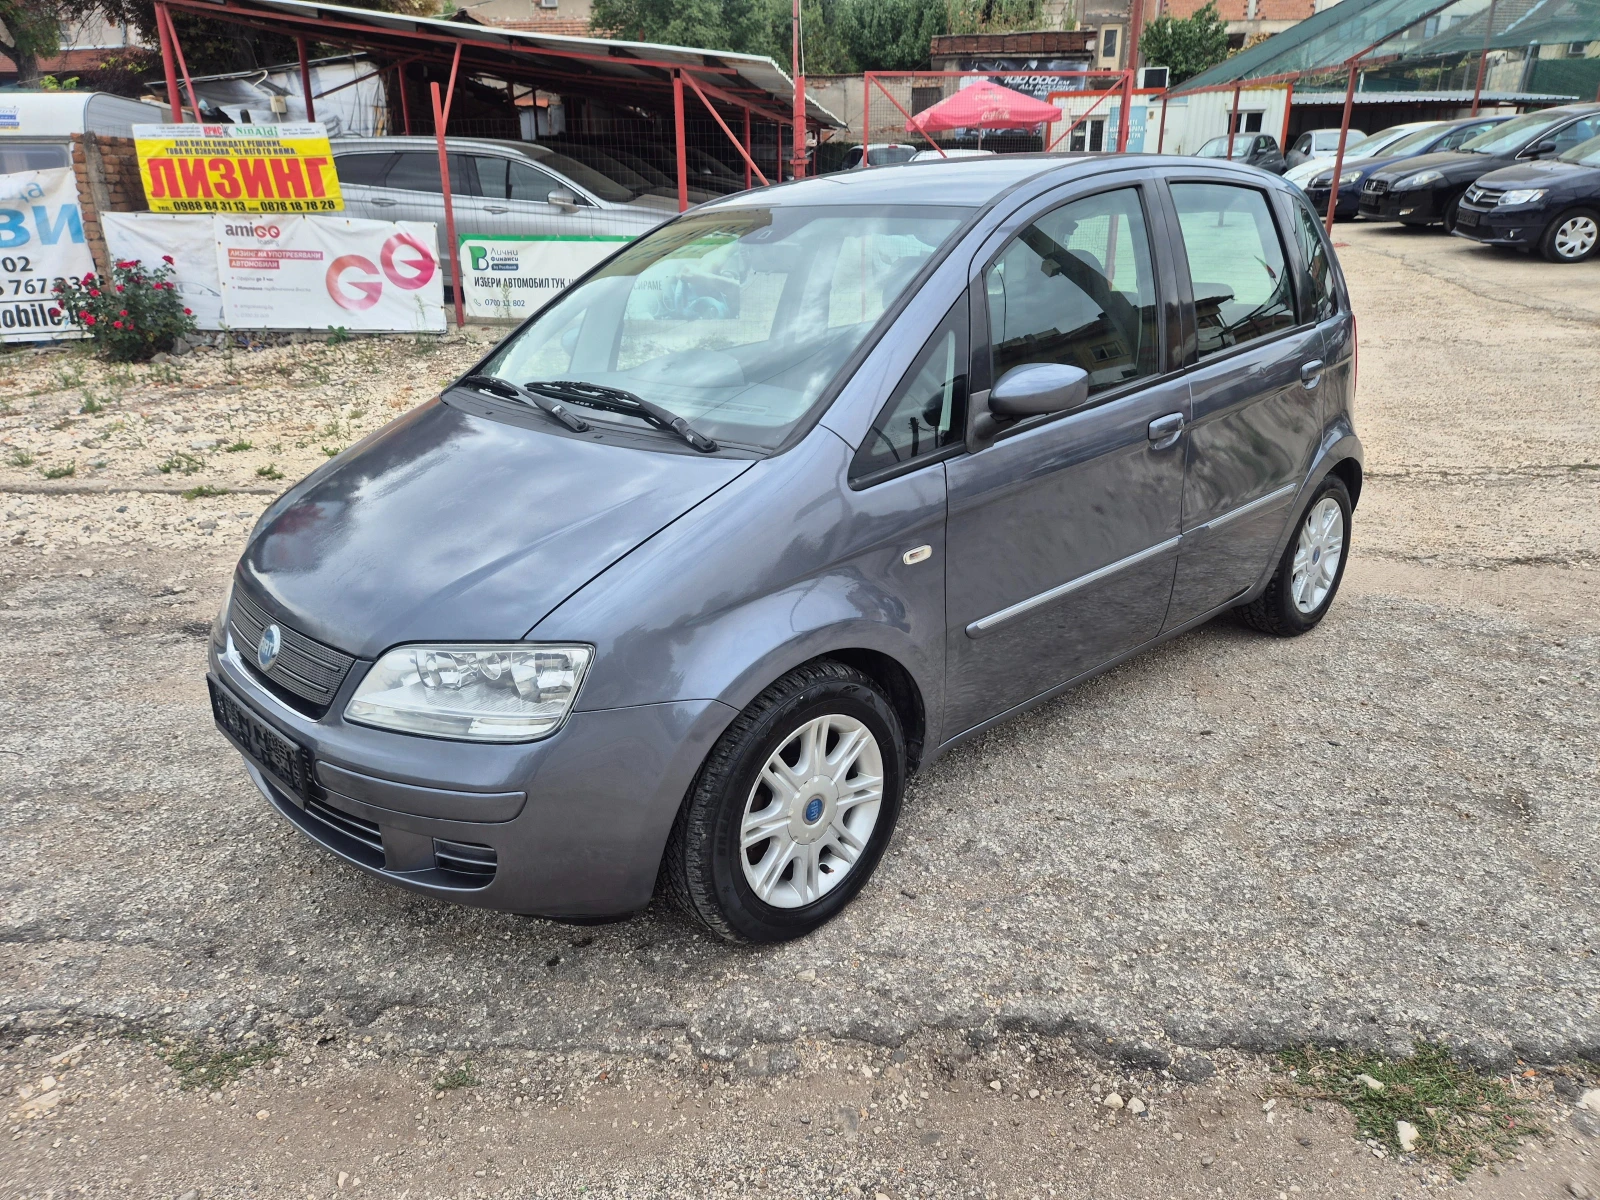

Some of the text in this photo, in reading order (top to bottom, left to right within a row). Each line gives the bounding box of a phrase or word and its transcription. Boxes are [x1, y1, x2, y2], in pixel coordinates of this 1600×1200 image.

[212, 140, 246, 148] ВИЖДАТЕ
[165, 147, 184, 155] ТОВА
[184, 147, 194, 155] НЕ
[234, 147, 243, 155] ЧЕ
[243, 147, 262, 155] НЕГО
[147, 158, 328, 199] ЛИЗИНГ
[173, 201, 202, 211] 0988
[204, 201, 218, 211] 84
[219, 201, 232, 211] 31
[233, 201, 246, 211] 13
[260, 201, 287, 211] 0878
[289, 201, 303, 211] 18
[303, 201, 318, 211] 78
[319, 200, 335, 210] 28
[267, 251, 321, 259] УПОТРЕБЯВАНИ
[490, 247, 518, 256] Лични
[231, 260, 278, 268] АВТОМОБИЛИ
[8, 278, 47, 296] 767
[474, 276, 501, 288] ИЗБЕРИ
[502, 277, 550, 289] АВТОМОБИЛ
[484, 298, 500, 307] 0700
[512, 299, 526, 307] 802
[810, 800, 819, 820] FIAT
